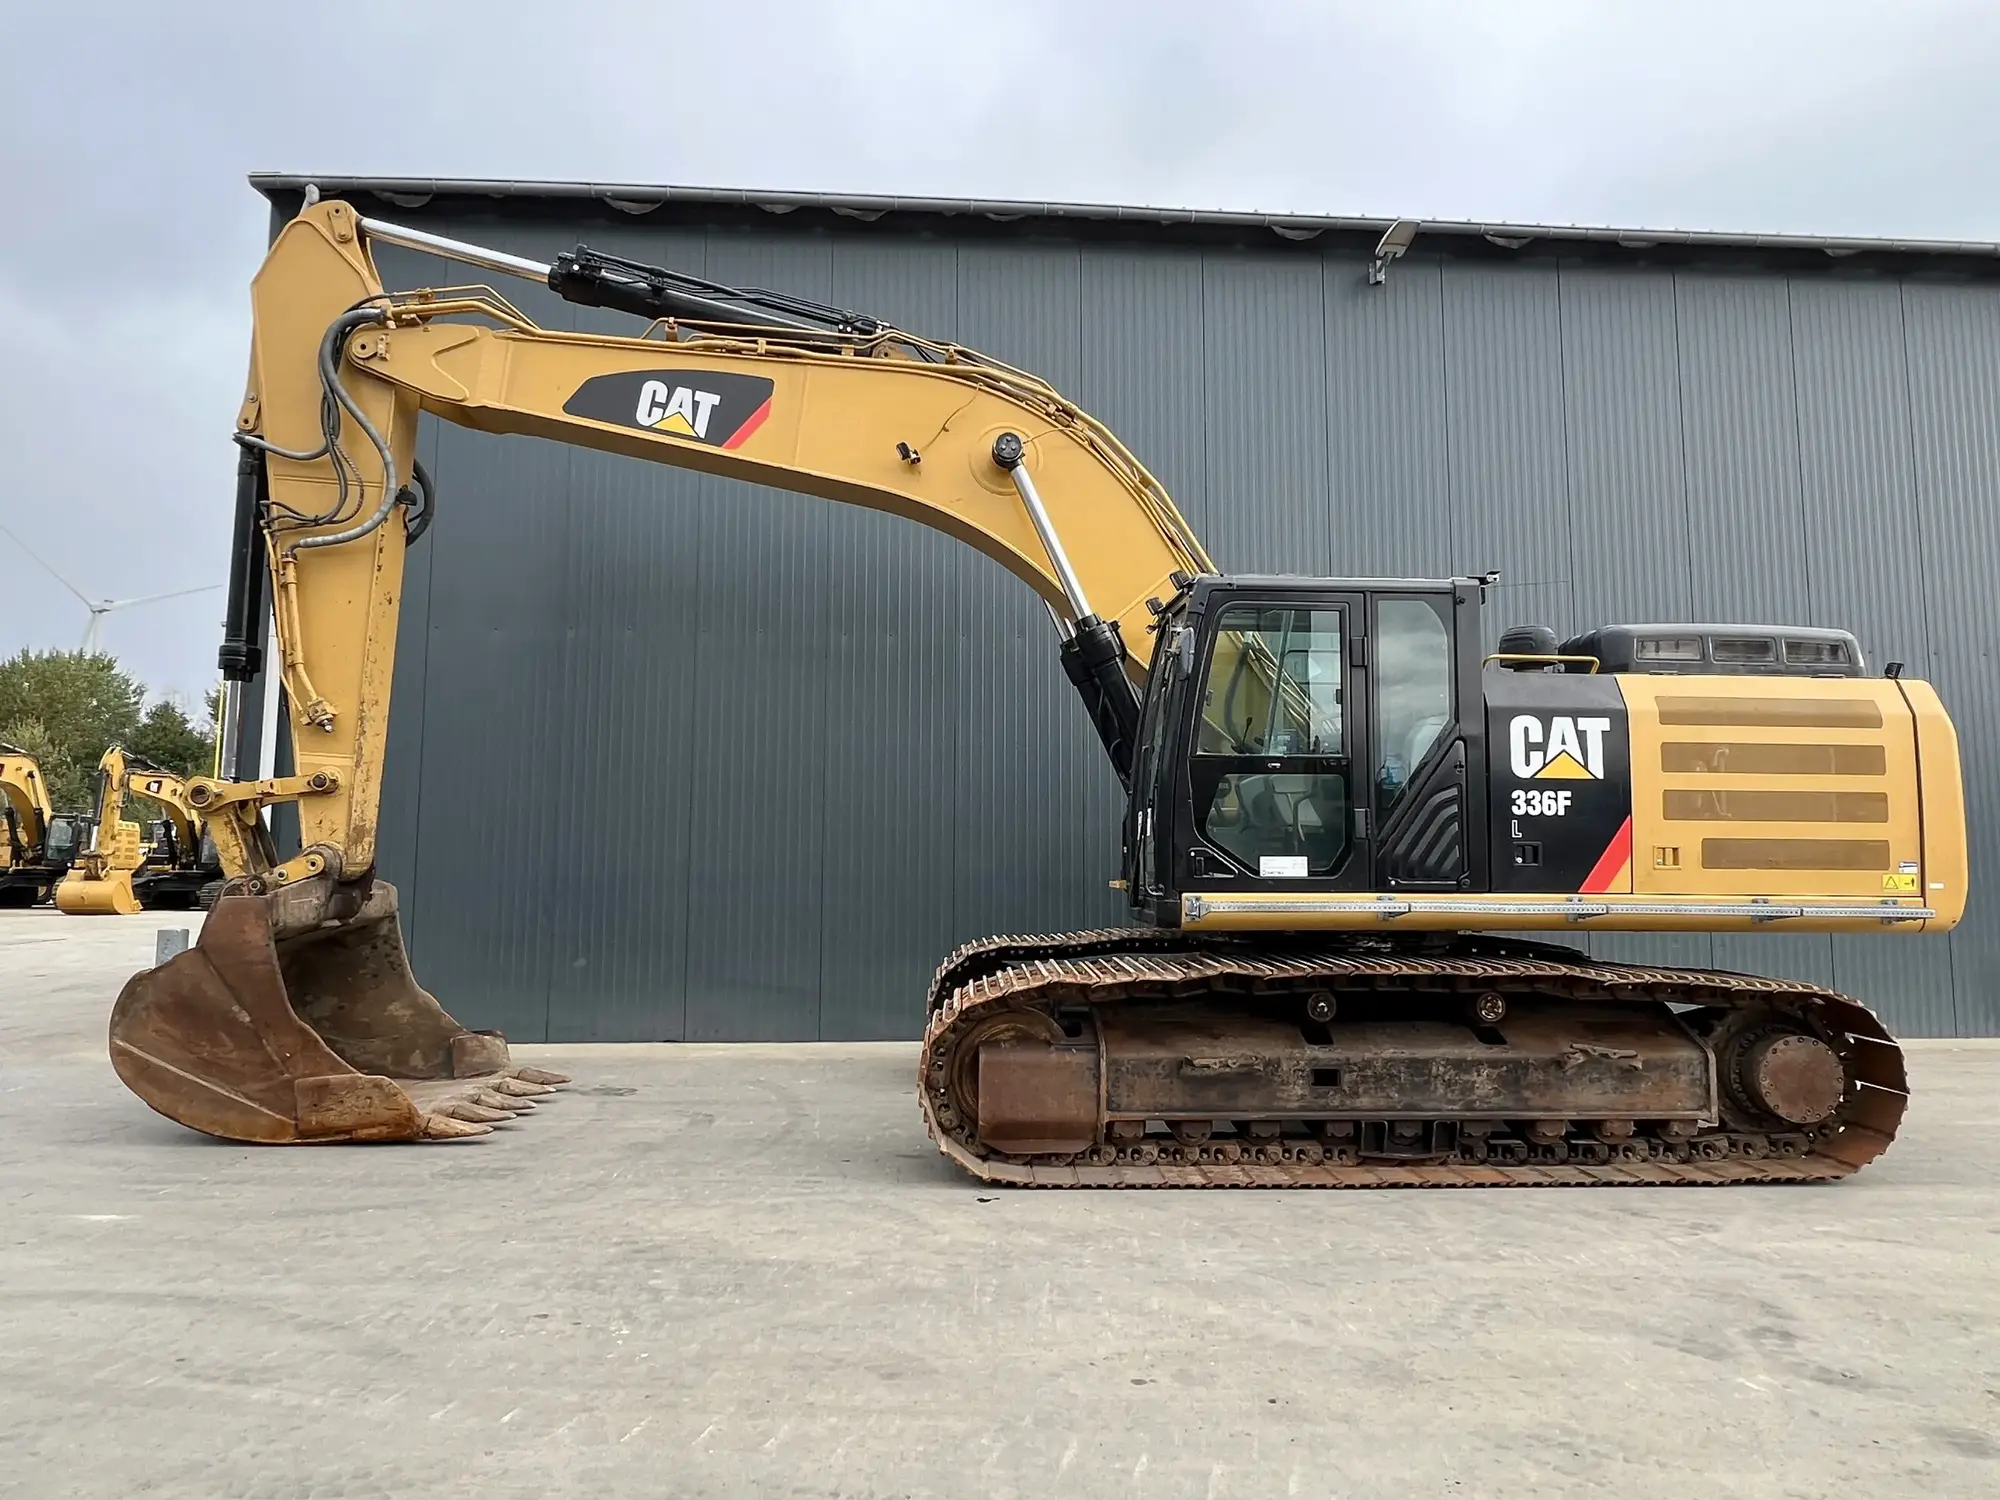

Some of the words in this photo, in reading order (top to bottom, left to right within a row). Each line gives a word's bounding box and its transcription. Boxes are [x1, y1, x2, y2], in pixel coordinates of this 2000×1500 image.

[635, 380, 721, 439] CAT
[1509, 714, 1611, 780] CAT
[1511, 789, 1572, 816] 336F
[1511, 819, 1523, 838] L
